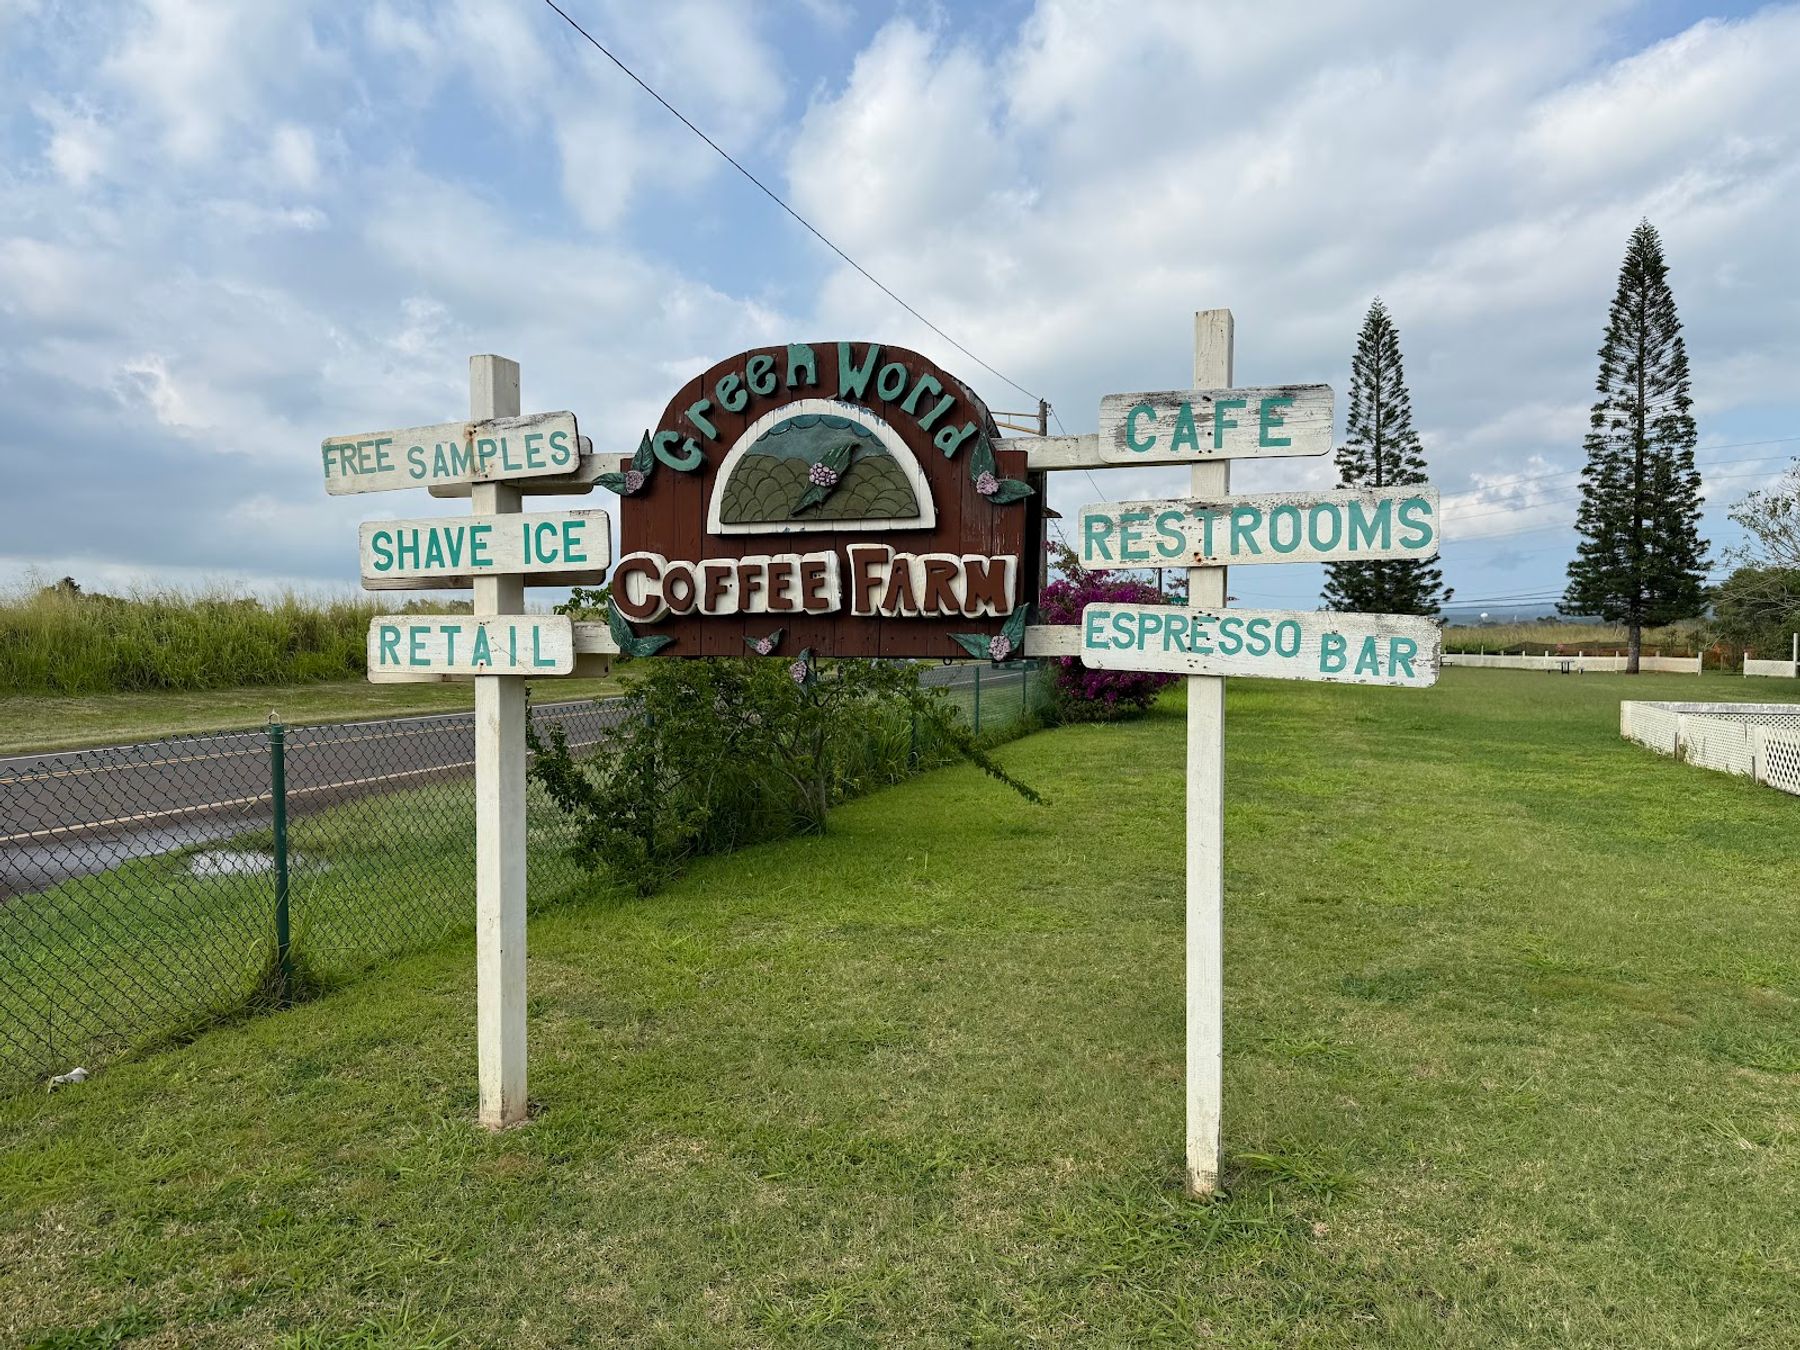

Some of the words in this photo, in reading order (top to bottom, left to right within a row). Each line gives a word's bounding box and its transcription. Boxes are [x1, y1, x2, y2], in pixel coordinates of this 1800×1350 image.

[652, 343, 819, 472] Green
[837, 341, 978, 459] World
[1126, 397, 1294, 453] CAFE
[322, 437, 395, 478] FREE
[407, 431, 571, 480] SAMPLES
[371, 525, 494, 572] SHAVE
[523, 520, 588, 565] ICE
[1083, 498, 1434, 562] RESTROOMS
[380, 625, 556, 667] RETAIL
[1085, 611, 1302, 658] ESPRESSO
[1319, 633, 1418, 679] BAR
